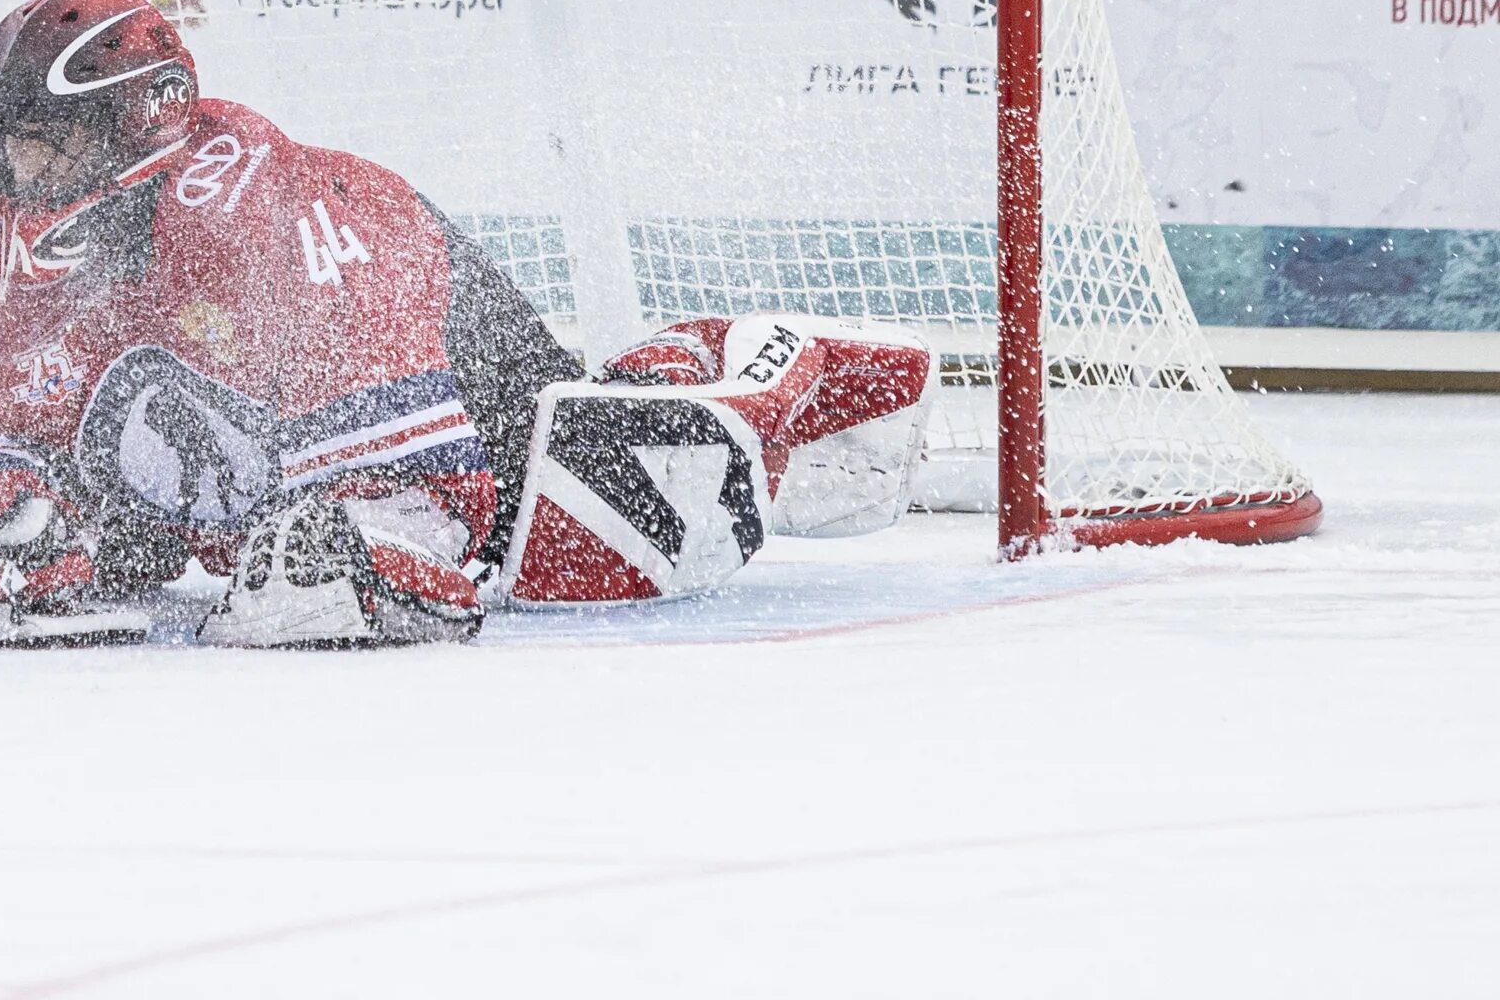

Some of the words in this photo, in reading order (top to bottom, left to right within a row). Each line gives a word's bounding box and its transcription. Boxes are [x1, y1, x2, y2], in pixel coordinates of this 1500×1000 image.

[804, 65, 919, 93] ЛИГА
[297, 199, 372, 288] 44
[737, 324, 800, 384] CCM
